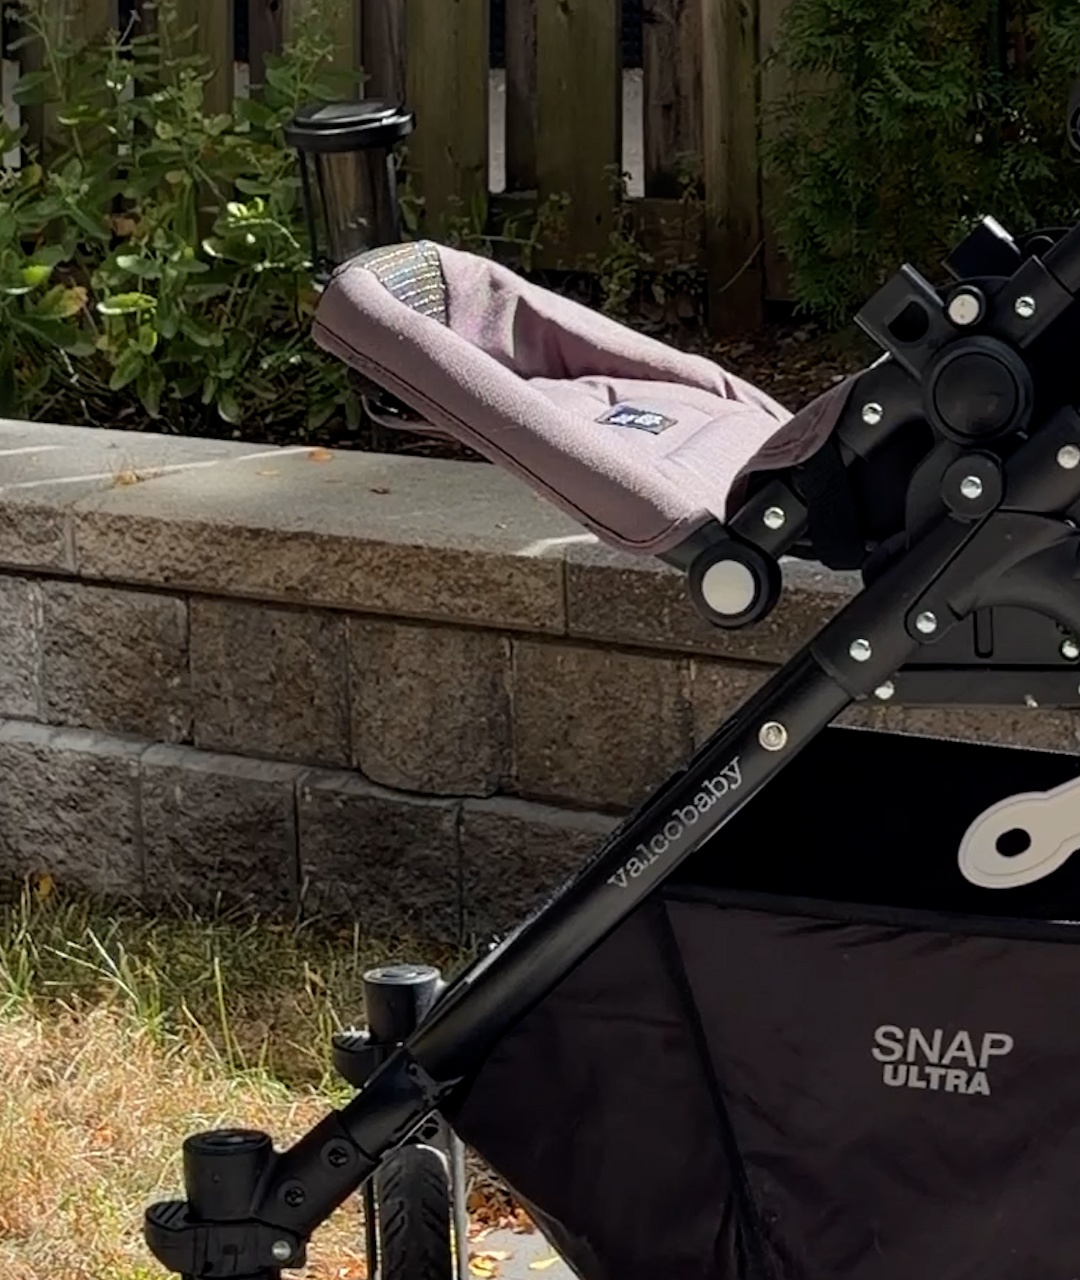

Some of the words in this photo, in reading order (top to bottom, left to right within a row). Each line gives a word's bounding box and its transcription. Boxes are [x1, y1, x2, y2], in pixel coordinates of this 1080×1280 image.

[607, 756, 742, 888] valcobaby
[871, 1024, 1014, 1068] SNAP
[883, 1064, 991, 1096] ULTRA
